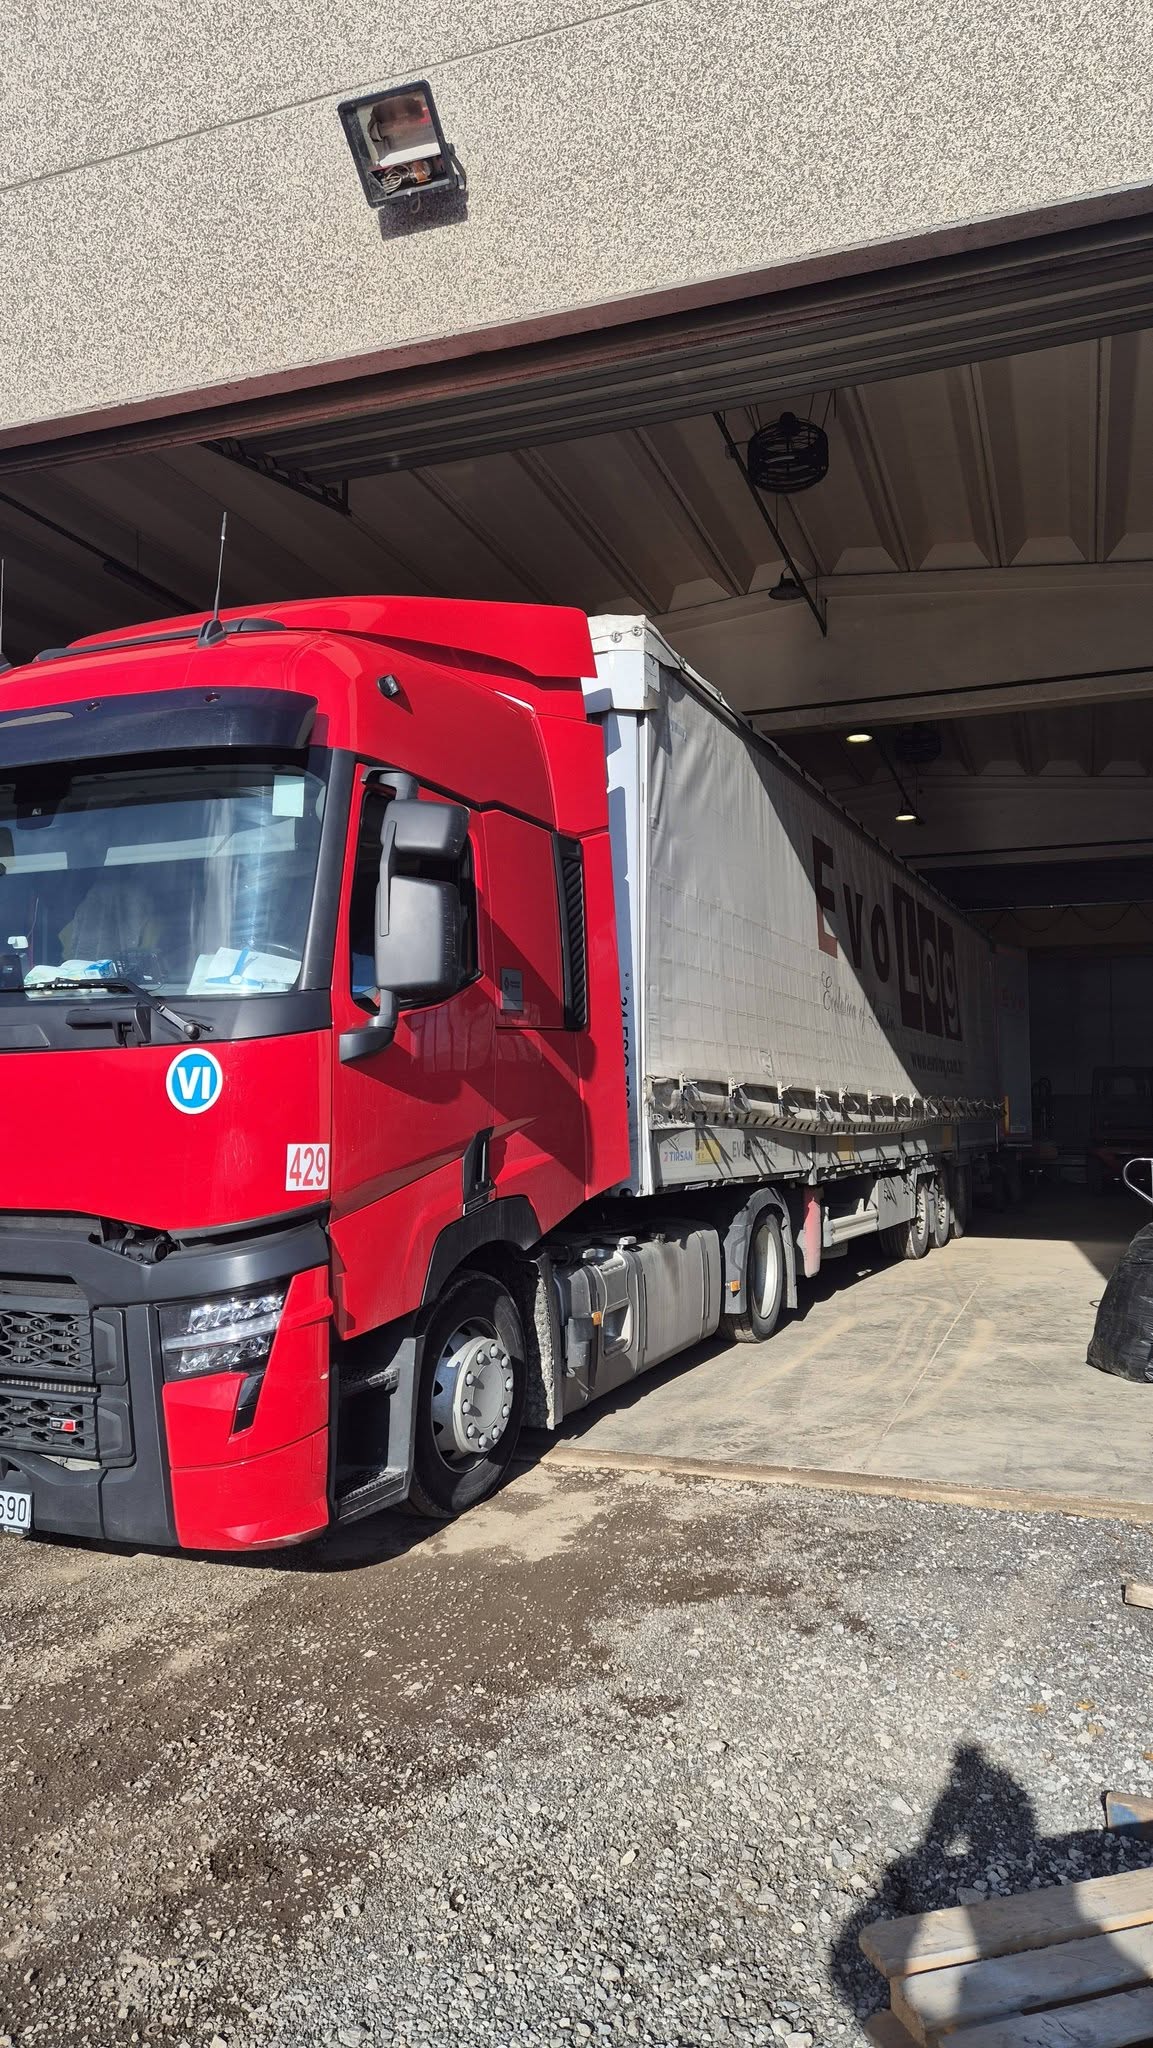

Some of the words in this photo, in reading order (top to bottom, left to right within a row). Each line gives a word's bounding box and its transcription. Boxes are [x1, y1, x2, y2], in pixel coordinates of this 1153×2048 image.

[176, 1066, 211, 1100] VI
[289, 1147, 326, 1187] 429
[669, 1151, 693, 1162] TIRSAN
